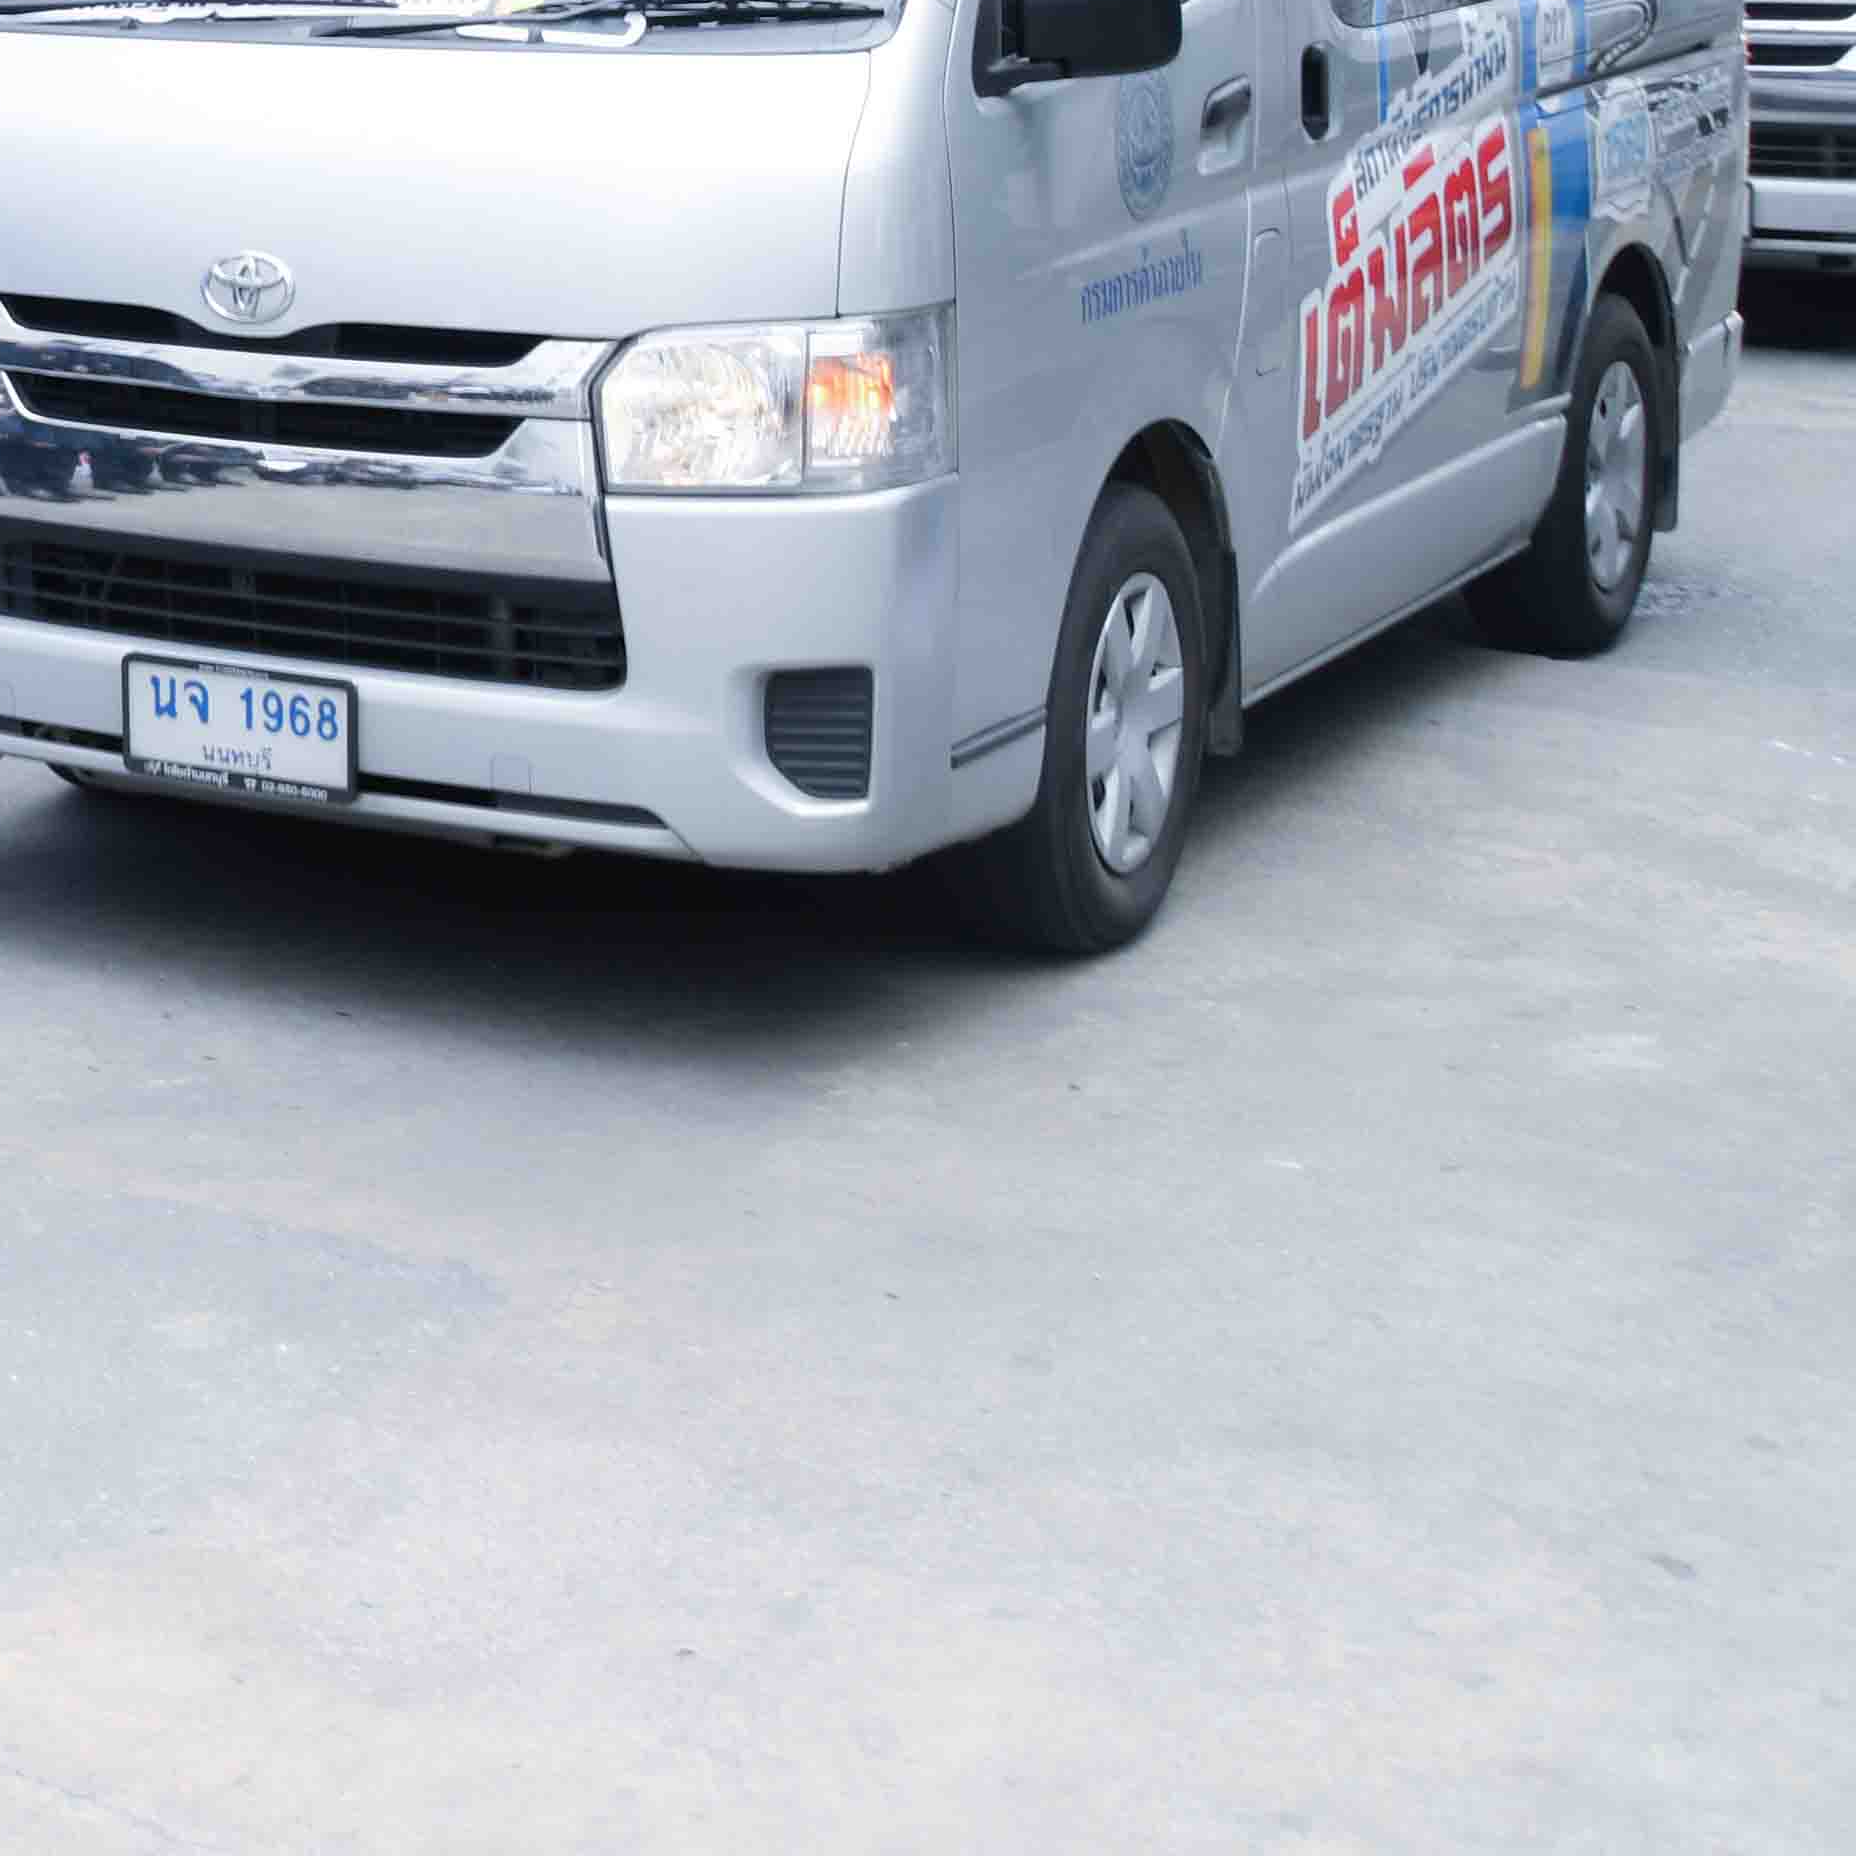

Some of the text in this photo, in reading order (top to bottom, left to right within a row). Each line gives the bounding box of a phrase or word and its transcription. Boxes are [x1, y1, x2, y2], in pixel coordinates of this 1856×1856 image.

[1302, 120, 1513, 445] เต็มลิตร
[149, 674, 339, 742] นจ 1968
